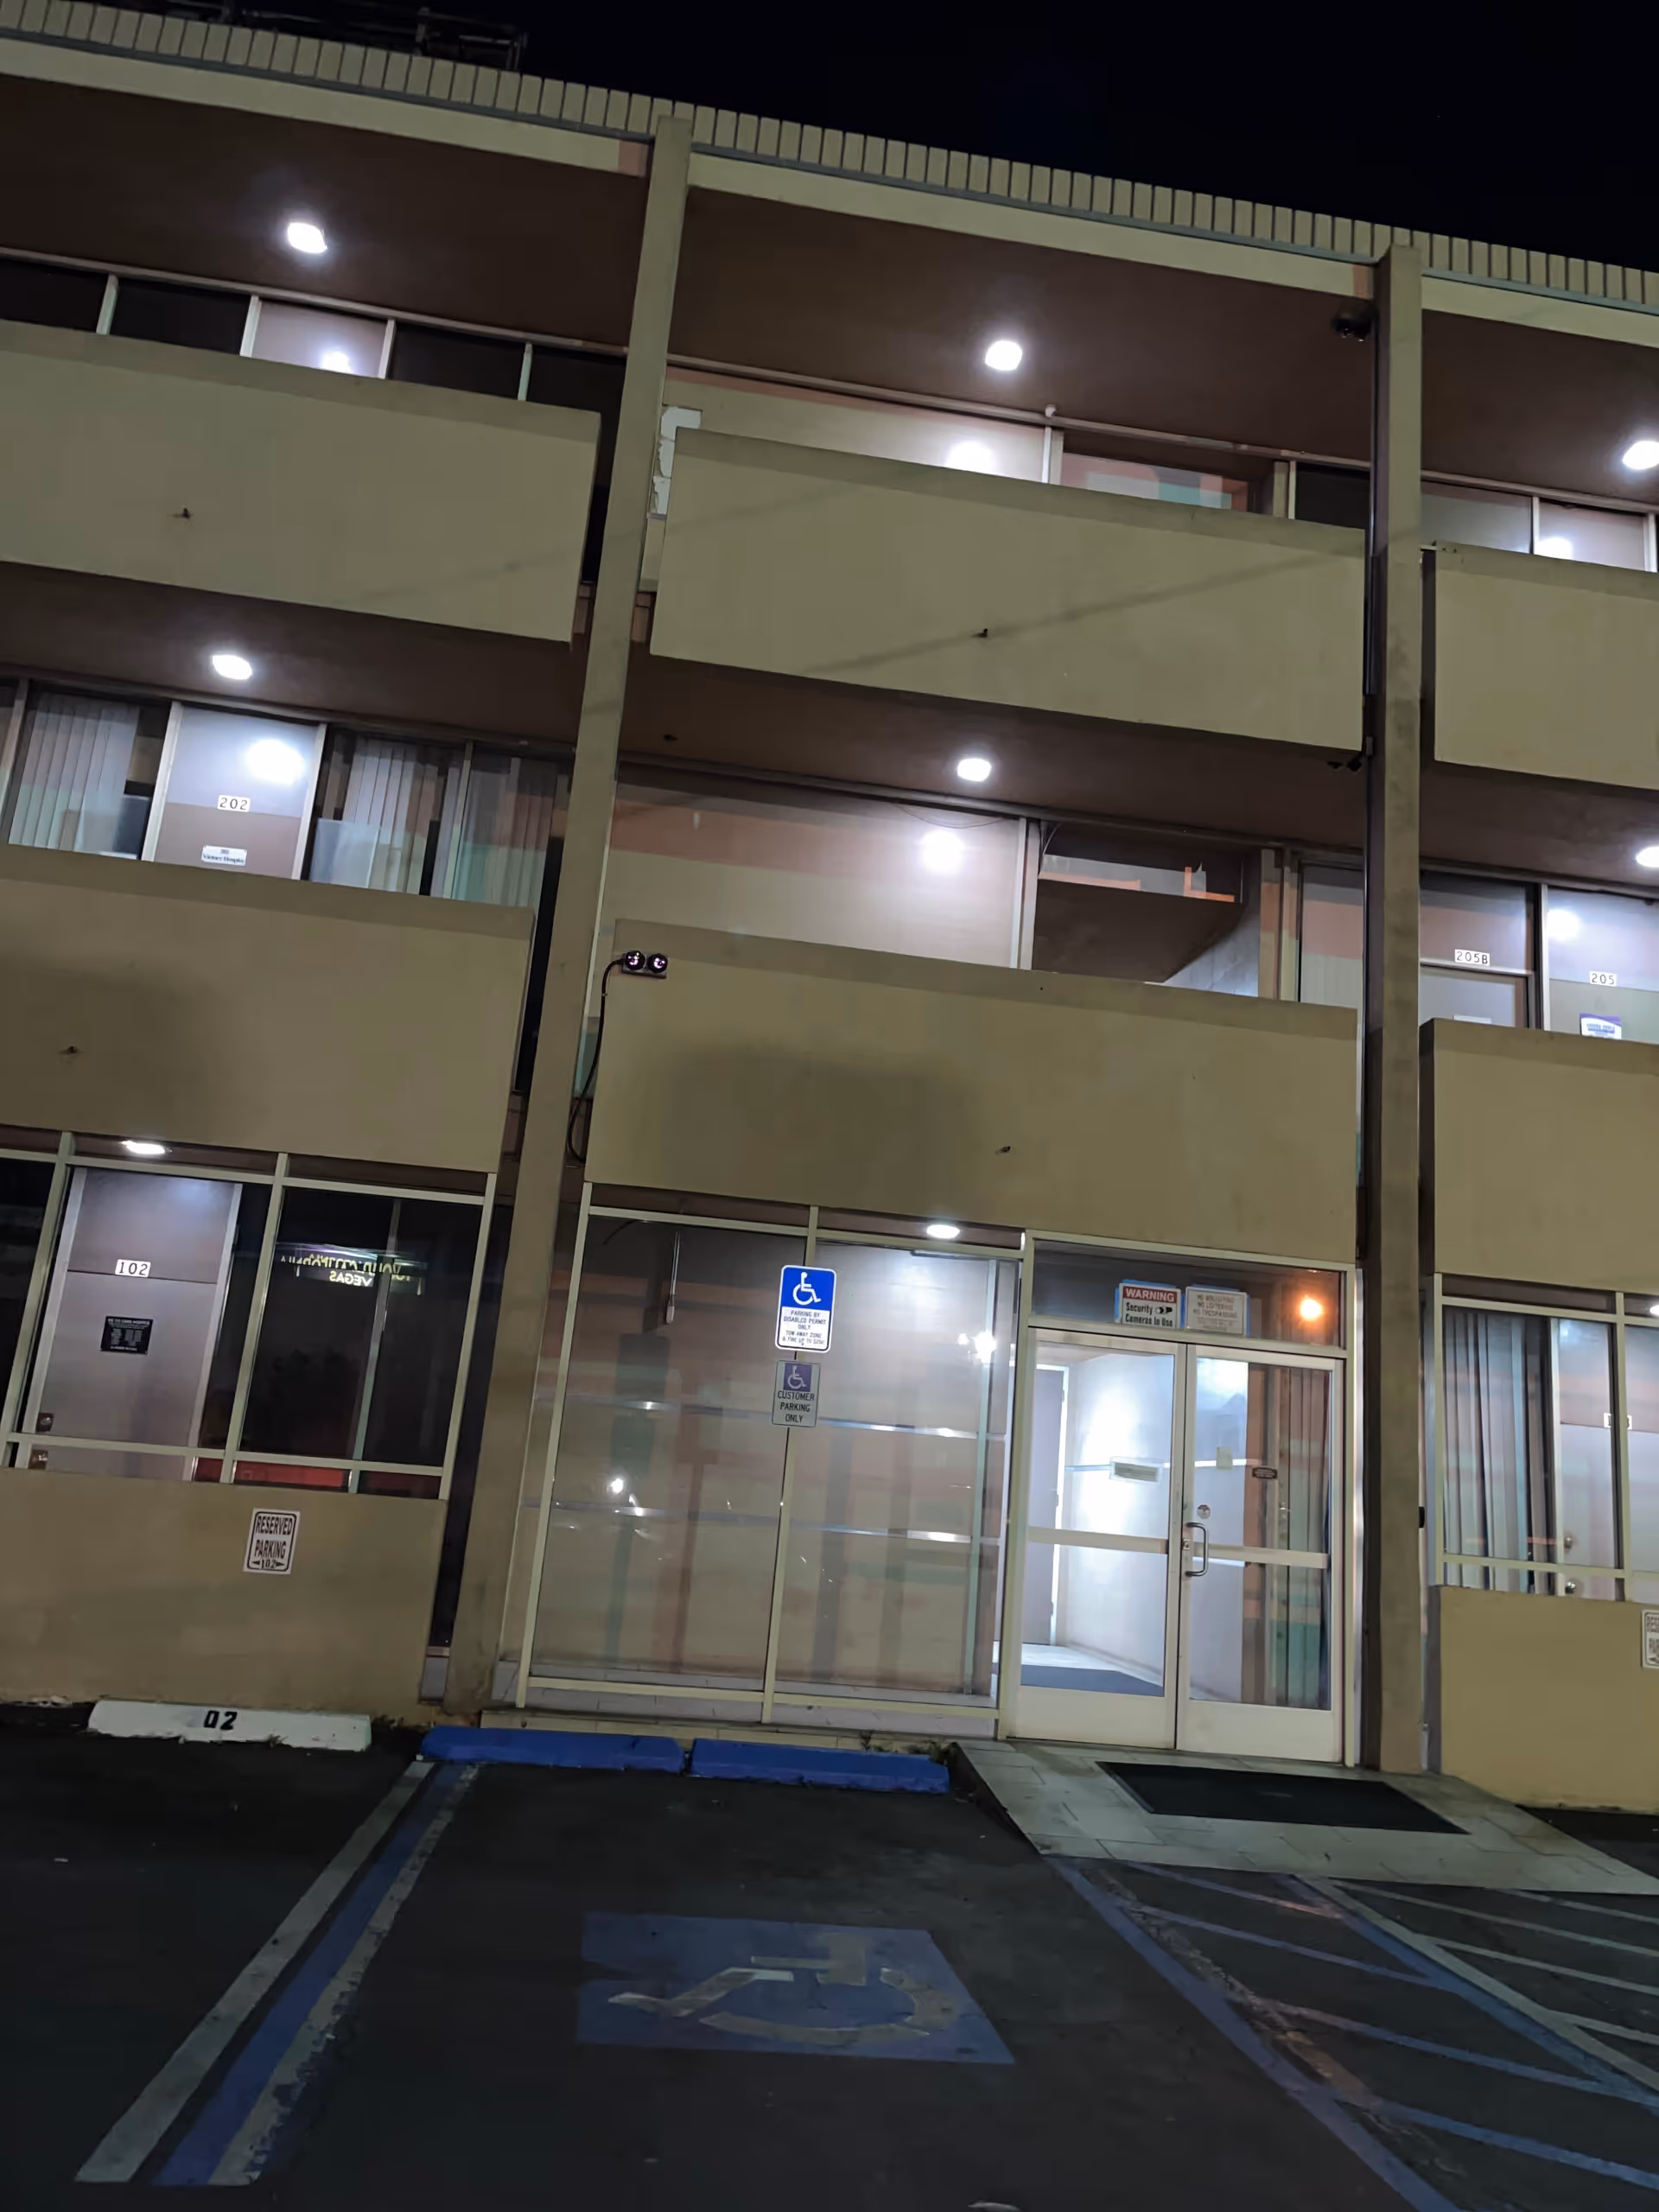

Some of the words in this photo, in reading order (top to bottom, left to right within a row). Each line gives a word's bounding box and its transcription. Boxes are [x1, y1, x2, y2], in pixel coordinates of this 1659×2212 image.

[219, 797, 248, 810] 202
[1457, 950, 1488, 964] 205B
[1592, 973, 1614, 985] 205
[118, 1262, 148, 1275] 102
[1125, 1287, 1175, 1302] WARNING
[791, 1309, 812, 1318] PARKING
[1125, 1301, 1153, 1315] Security
[783, 1315, 807, 1324] DISABLED
[1125, 1313, 1152, 1325] Cameras
[777, 1390, 815, 1401] CUSTOMER
[779, 1402, 810, 1412] PARKING
[785, 1413, 804, 1423] ONLY
[256, 1516, 293, 1535] RESERVED
[254, 1539, 287, 1559] PARKING
[261, 1558, 276, 1570] 102
[203, 1710, 238, 1730] 02
